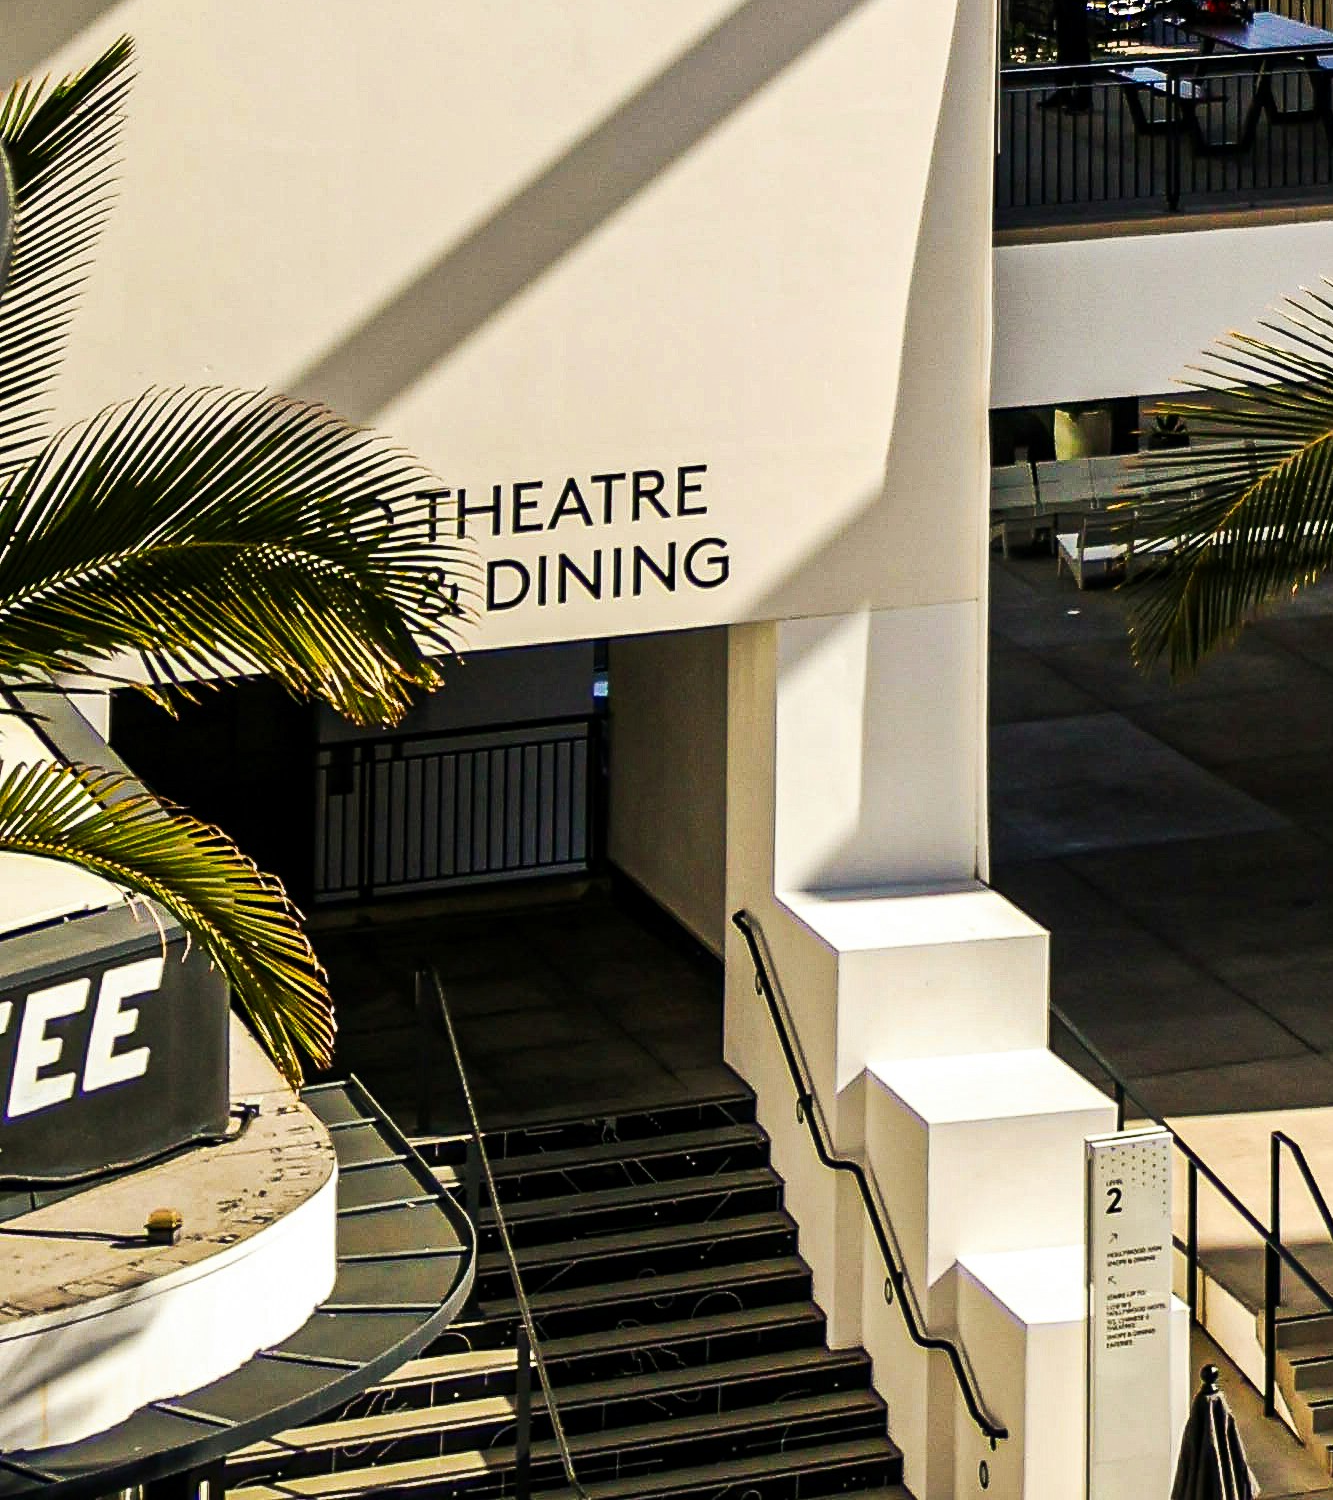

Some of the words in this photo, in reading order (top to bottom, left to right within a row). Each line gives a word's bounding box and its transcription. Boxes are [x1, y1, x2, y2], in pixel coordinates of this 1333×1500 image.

[417, 465, 708, 542] THEATRE
[487, 537, 731, 611] DINING
[0, 957, 165, 1118] EE
[1106, 1187, 1122, 1214] 2
